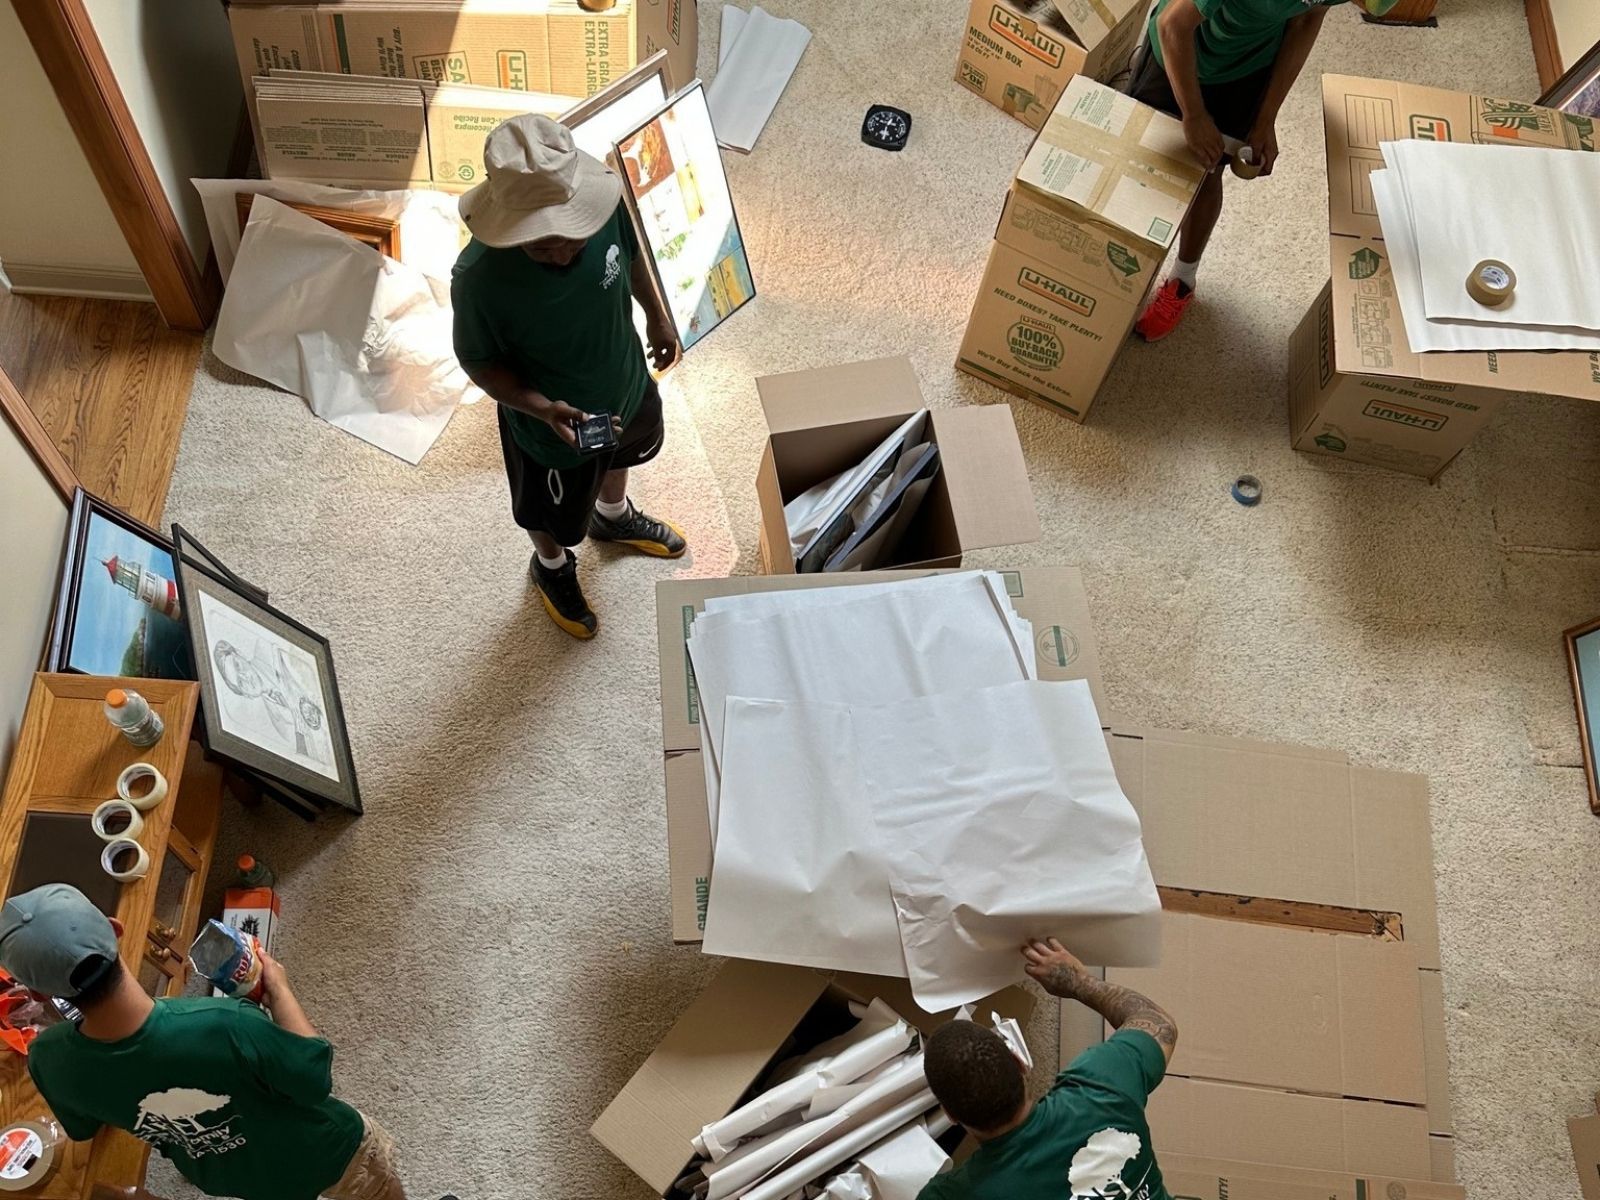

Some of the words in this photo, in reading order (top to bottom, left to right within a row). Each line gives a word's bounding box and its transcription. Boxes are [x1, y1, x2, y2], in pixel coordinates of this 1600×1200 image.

[598, 20, 610, 58] EXTRA
[969, 26, 1005, 55] MEDIUM
[1005, 51, 1022, 68] BOX
[1024, 270, 1090, 309] U-HAUL
[993, 287, 1017, 302] NEED
[1016, 297, 1048, 317] BOXES?
[1049, 313, 1070, 327] TAKE
[1068, 322, 1103, 342] PLENTY!
[1010, 336, 1059, 360] BUY-BACK
[1018, 323, 1056, 350] 100%
[995, 358, 1012, 370] Buy
[1009, 345, 1059, 368] GUARANTEE
[1359, 380, 1398, 393] PLENTY!
[1396, 387, 1419, 399] TAKE
[1422, 393, 1455, 407] BOXES?
[1454, 401, 1480, 412] NEED
[1369, 406, 1440, 429] U-HAUL
[696, 876, 708, 932] GRANDE
